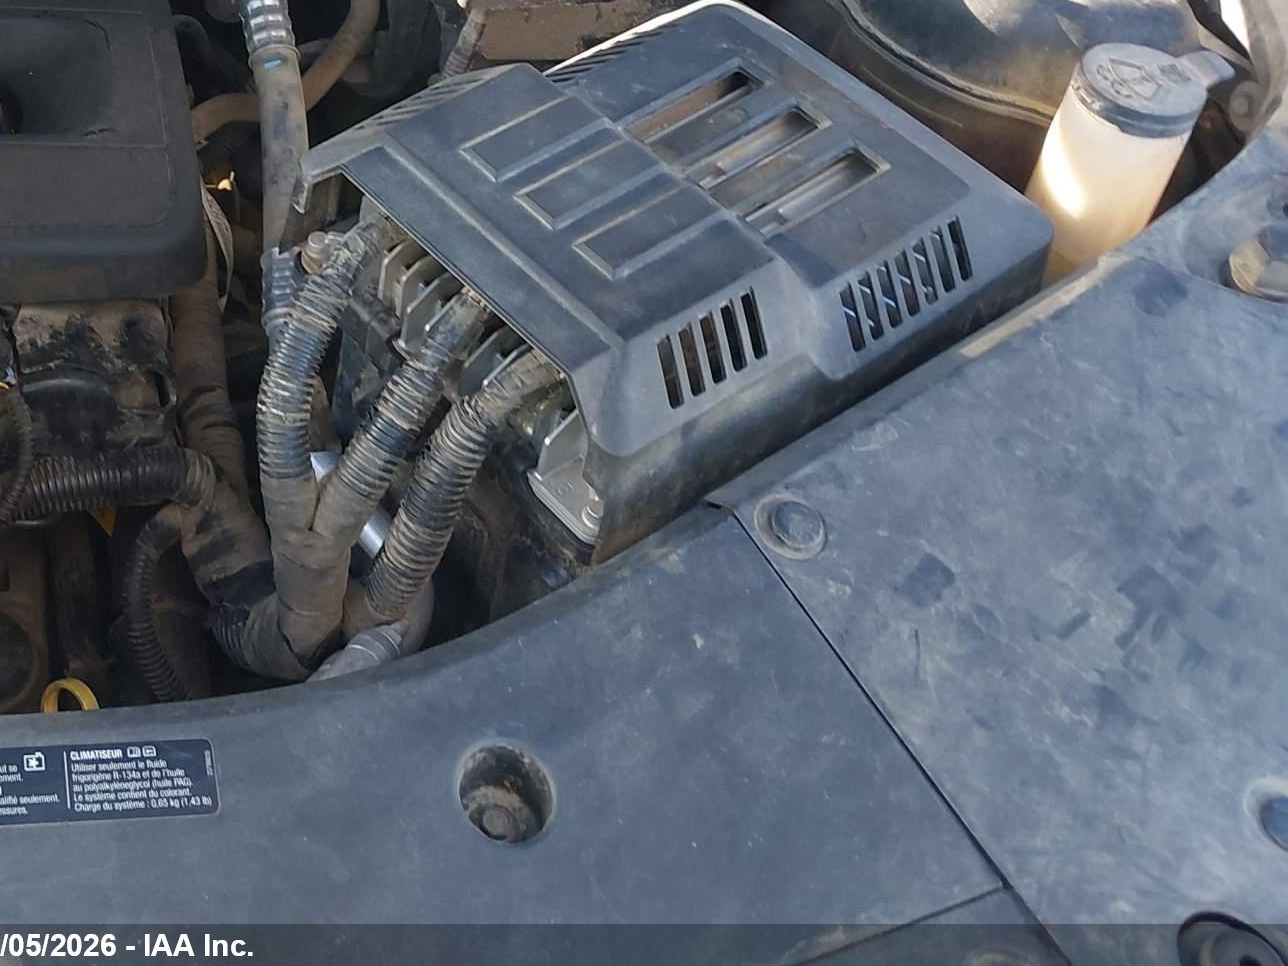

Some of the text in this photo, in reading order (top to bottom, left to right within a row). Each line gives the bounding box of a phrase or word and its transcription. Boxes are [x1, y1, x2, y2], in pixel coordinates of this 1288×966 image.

[70, 749, 122, 761] CLIMATISEUR
[72, 763, 96, 773] Utiliser
[98, 760, 136, 772] seulement
[146, 759, 167, 768] fluide
[113, 770, 141, 780] R-134a
[117, 791, 147, 801] contient
[74, 803, 101, 814] Charge
